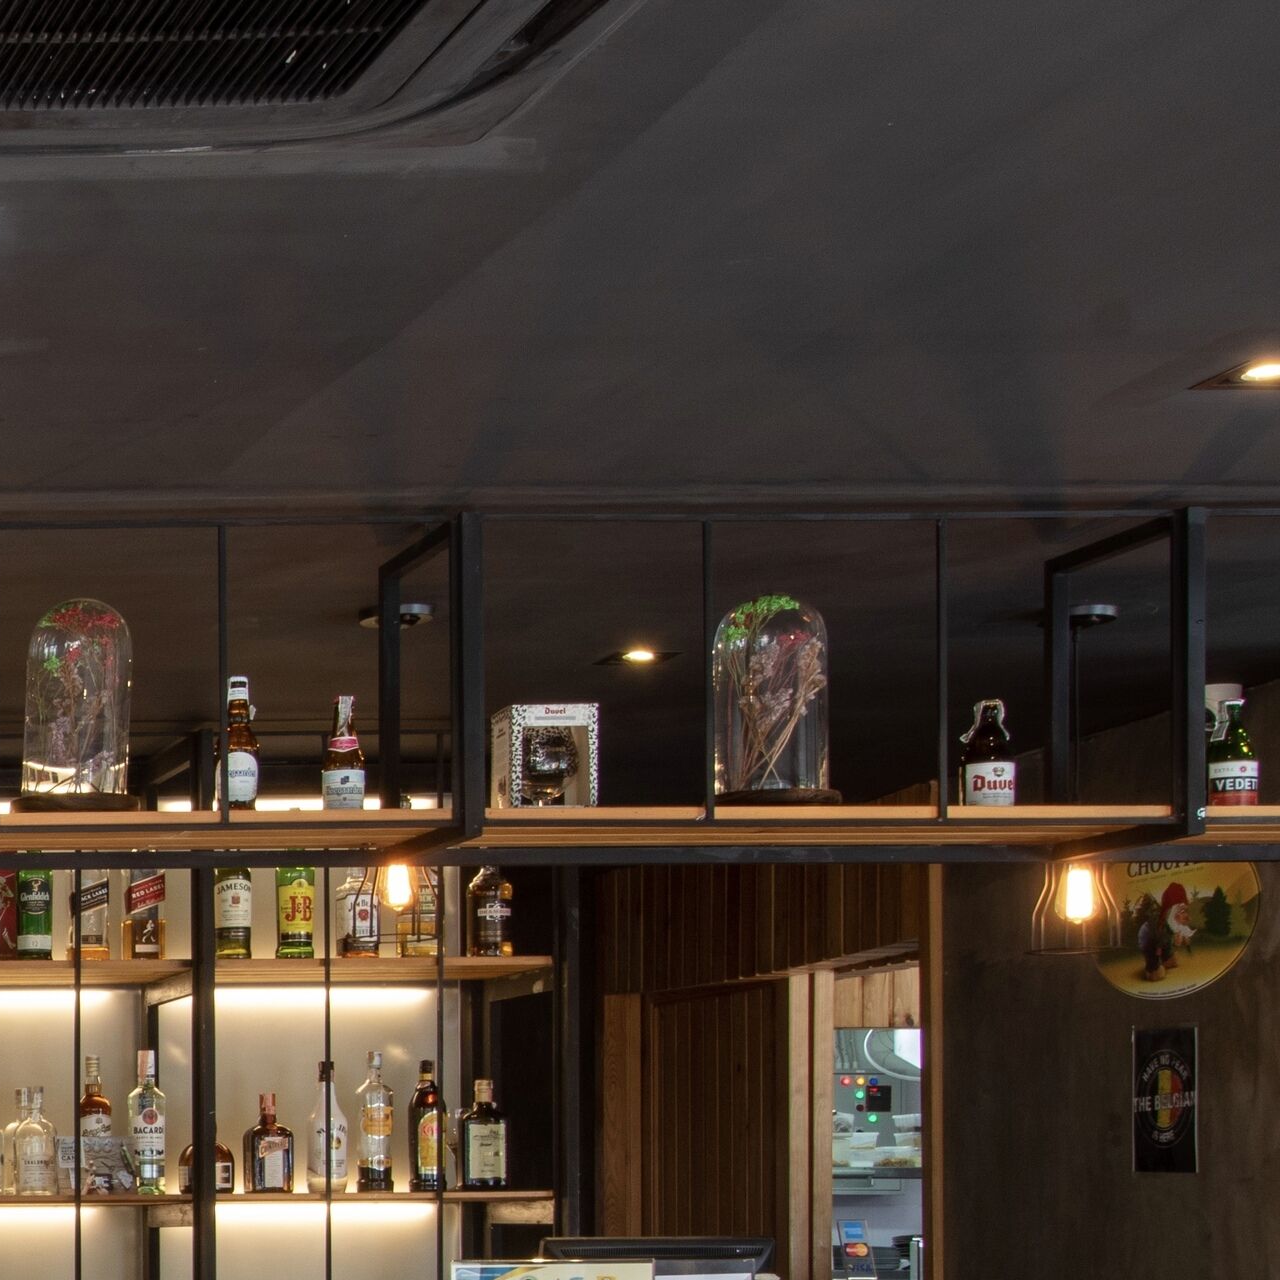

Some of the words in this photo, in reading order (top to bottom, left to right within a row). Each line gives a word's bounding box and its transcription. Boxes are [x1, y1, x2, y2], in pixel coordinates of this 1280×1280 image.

[544, 707, 566, 715] Duvel
[972, 774, 1014, 791] Duve
[131, 890, 145, 899] RED
[145, 883, 164, 894] LABEL
[217, 882, 251, 895] JAMESON
[284, 896, 312, 922] J&B
[1134, 1096, 1152, 1112] THE
